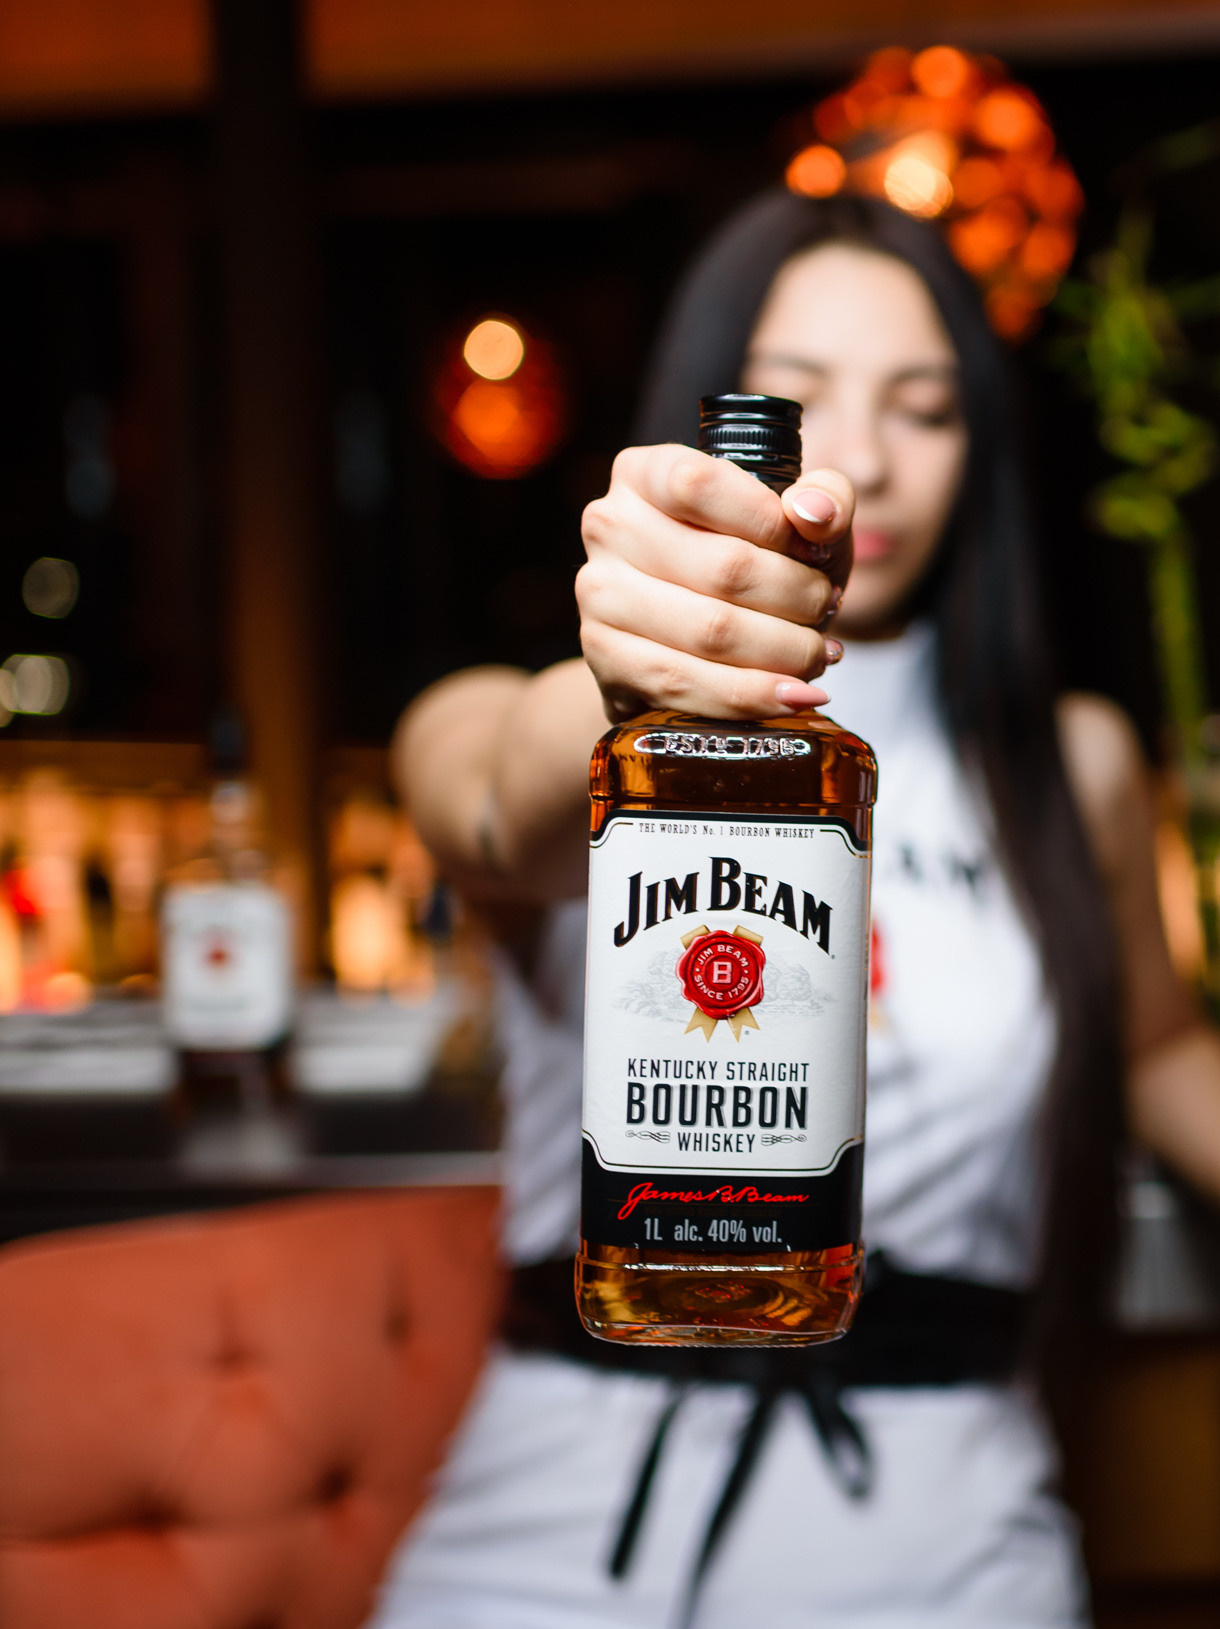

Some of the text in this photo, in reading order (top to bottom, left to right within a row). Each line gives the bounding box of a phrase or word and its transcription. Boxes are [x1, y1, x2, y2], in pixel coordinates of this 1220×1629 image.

[639, 822, 655, 833] THE
[660, 823, 698, 835] WORLD'S
[729, 826, 771, 837] BOURBON
[775, 828, 815, 838] WHISKEY
[613, 871, 700, 948] JIM
[707, 856, 834, 956] BEAM
[697, 945, 749, 967] JIM BEAM
[712, 961, 732, 983] B
[694, 975, 750, 1000] SINCE 1795
[627, 1058, 810, 1082] KENTUCKY STRAIGHT
[626, 1082, 808, 1129] BOURBON
[677, 1132, 756, 1153] WHISKEY
[617, 1182, 708, 1220] James
[735, 1186, 810, 1203] Beam
[644, 1218, 783, 1243] 1L alc. 40% vol.
